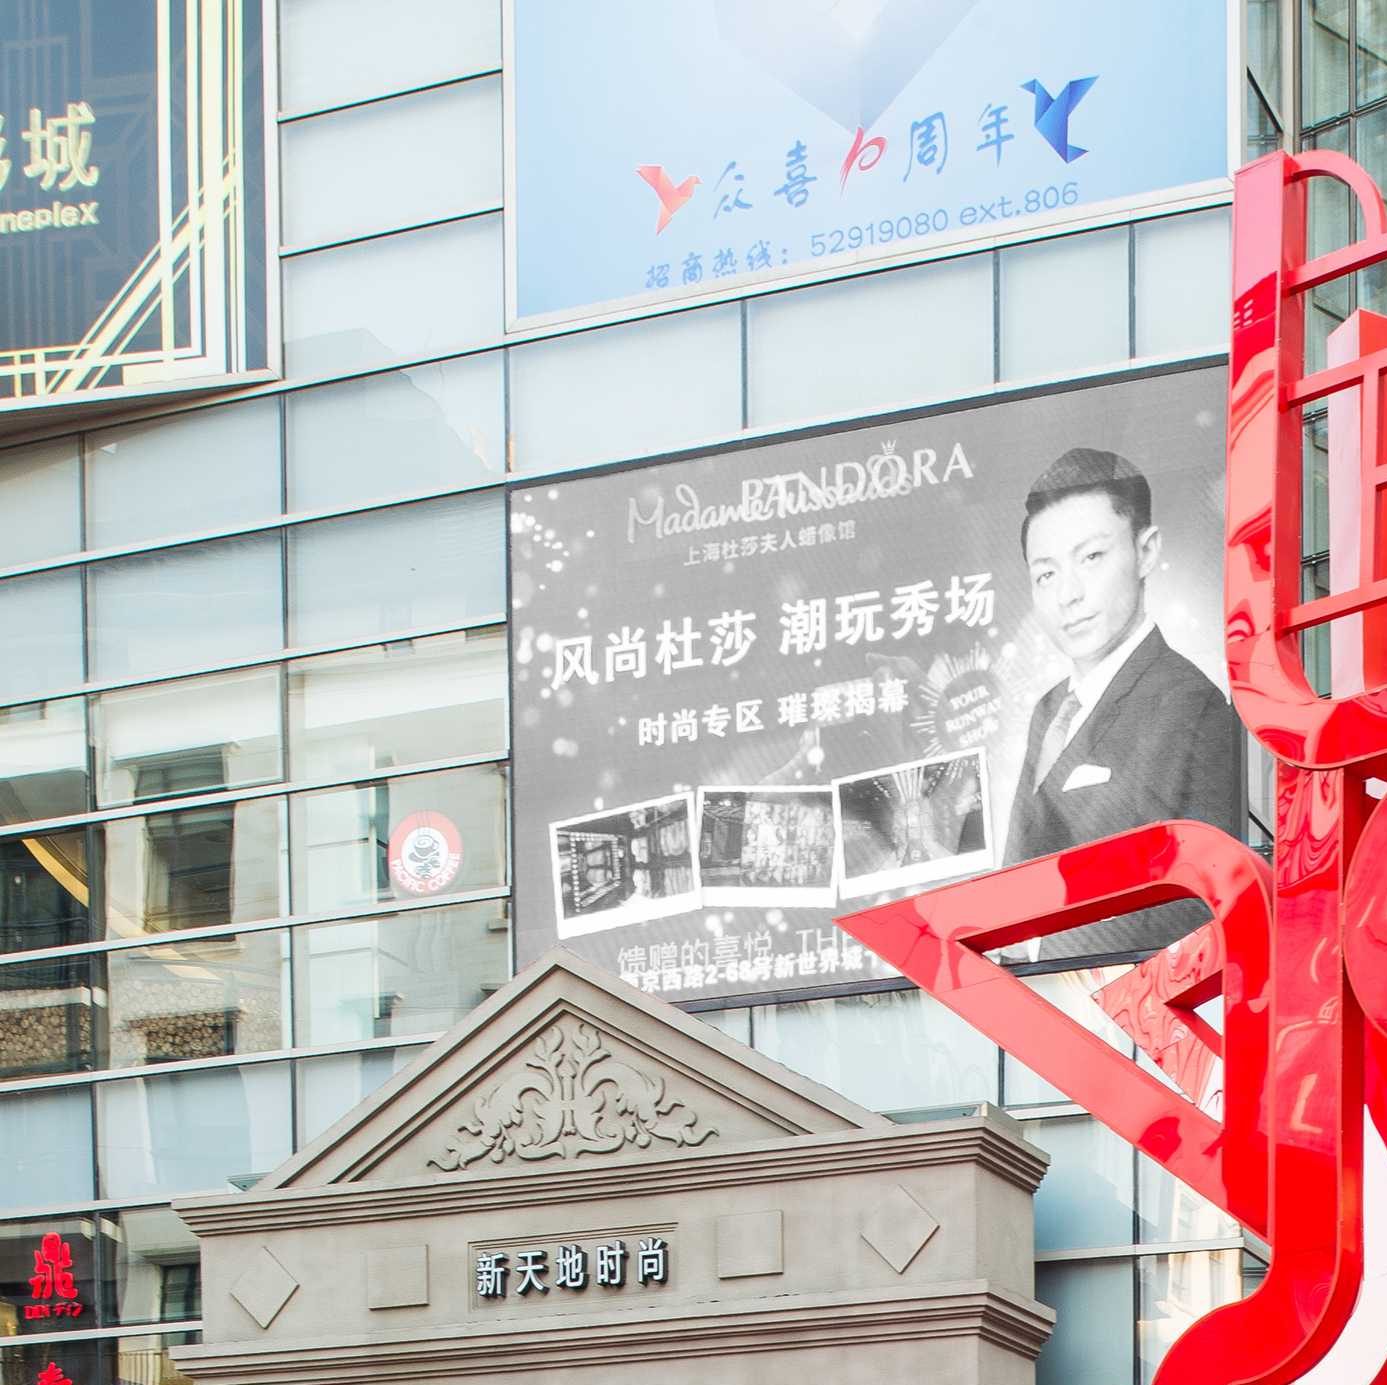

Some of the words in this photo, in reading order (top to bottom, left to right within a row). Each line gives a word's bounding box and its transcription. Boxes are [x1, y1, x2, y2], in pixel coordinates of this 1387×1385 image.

[0, 102, 98, 192] 城
[810, 209, 949, 258] 52919080
[959, 182, 1079, 226] ext.806
[742, 442, 974, 514] PANDORA
[683, 520, 857, 567] 上海杜莎夫人蜡像馆
[551, 610, 758, 689] 风尚杜莎
[778, 572, 996, 655] 潮玩秀场
[638, 699, 764, 746] 时尚专区
[777, 678, 909, 727] 璀璨揭幕
[617, 931, 773, 973] 馈赠的喜悦
[476, 1238, 670, 1297] 新天地时尚
